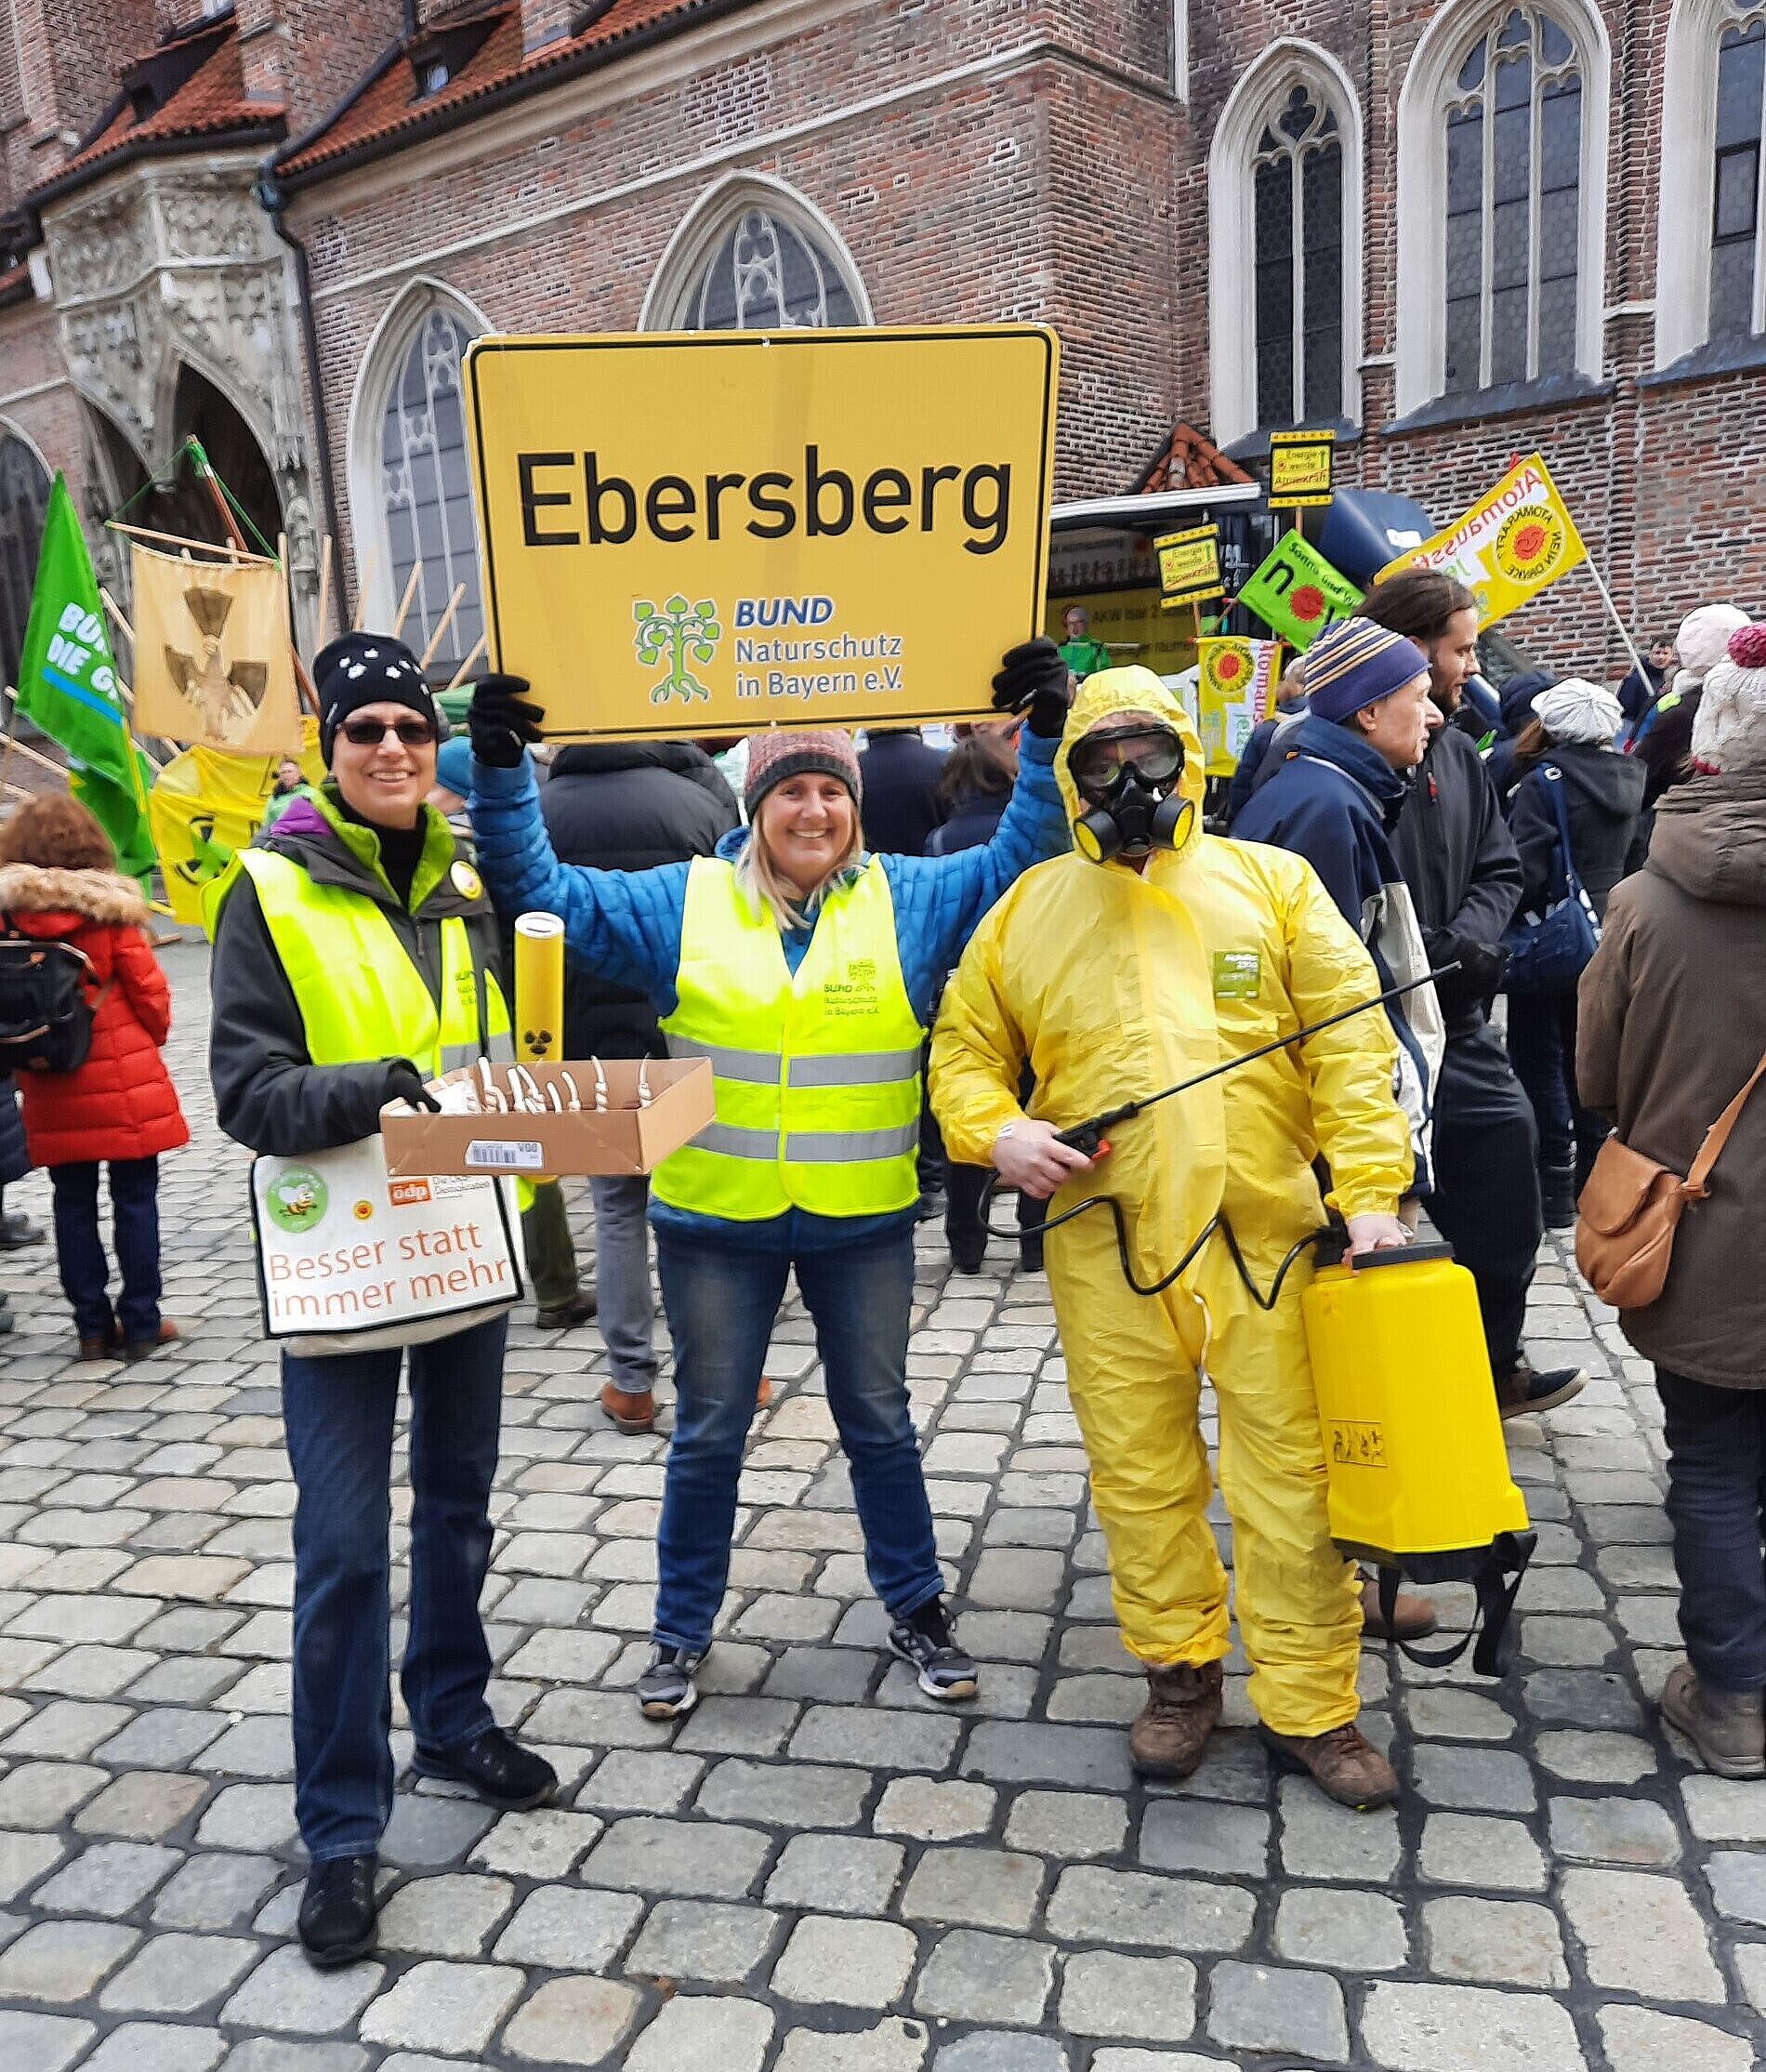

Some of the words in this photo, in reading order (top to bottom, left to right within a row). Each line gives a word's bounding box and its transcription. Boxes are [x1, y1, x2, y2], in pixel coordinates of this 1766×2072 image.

[517, 444, 1011, 555] Ebersberg
[735, 597, 834, 627] BUND
[736, 634, 902, 663] Naturschutz
[737, 674, 759, 696] in
[769, 671, 856, 699] Bayern
[863, 666, 903, 691] e.V.
[824, 983, 852, 993] BUND
[270, 1240, 386, 1281] Besser
[399, 1222, 483, 1261] statt
[272, 1279, 396, 1318] immer
[409, 1257, 507, 1300] mehr
